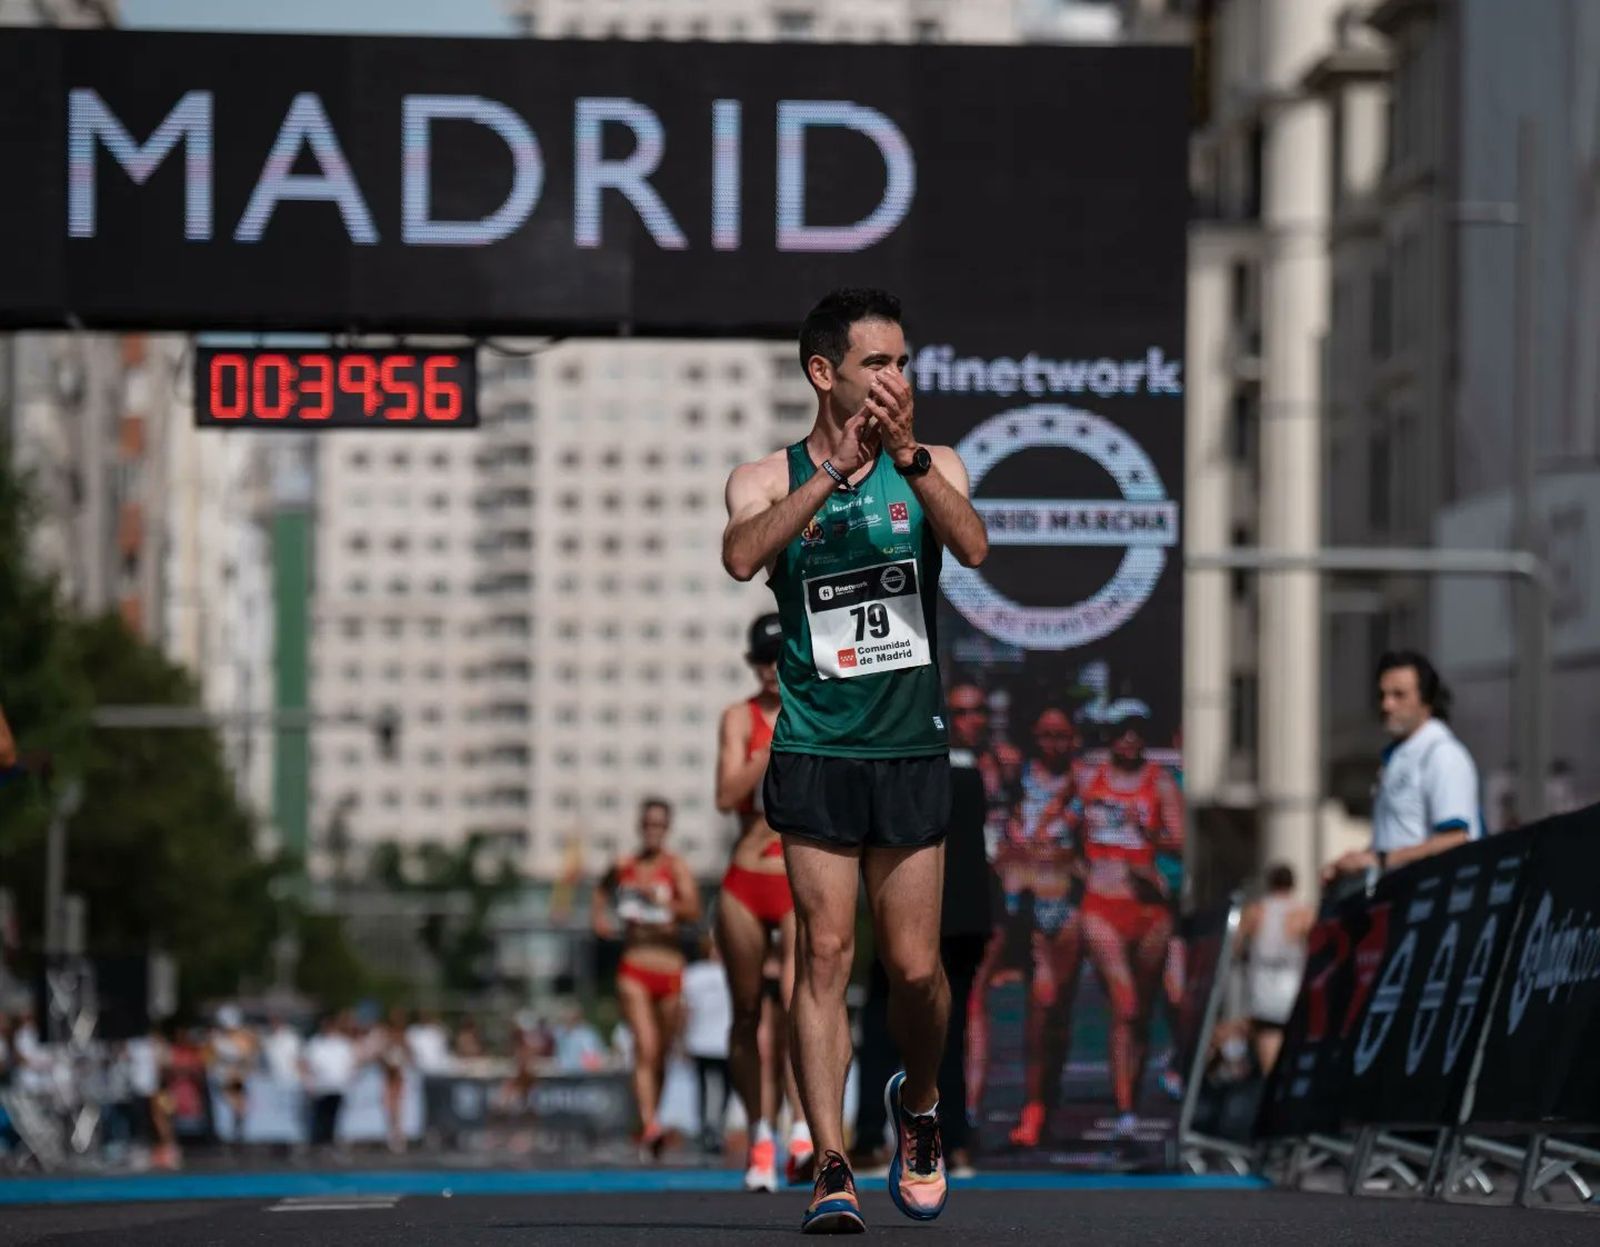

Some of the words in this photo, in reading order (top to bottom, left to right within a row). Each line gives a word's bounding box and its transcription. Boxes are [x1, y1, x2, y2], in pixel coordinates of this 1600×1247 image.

[67, 88, 917, 253] MADRID
[915, 346, 1183, 395] finetwork
[849, 603, 890, 642] 79
[857, 639, 911, 655] Comunidad
[859, 654, 873, 666] de
[876, 649, 912, 664] Madrid
